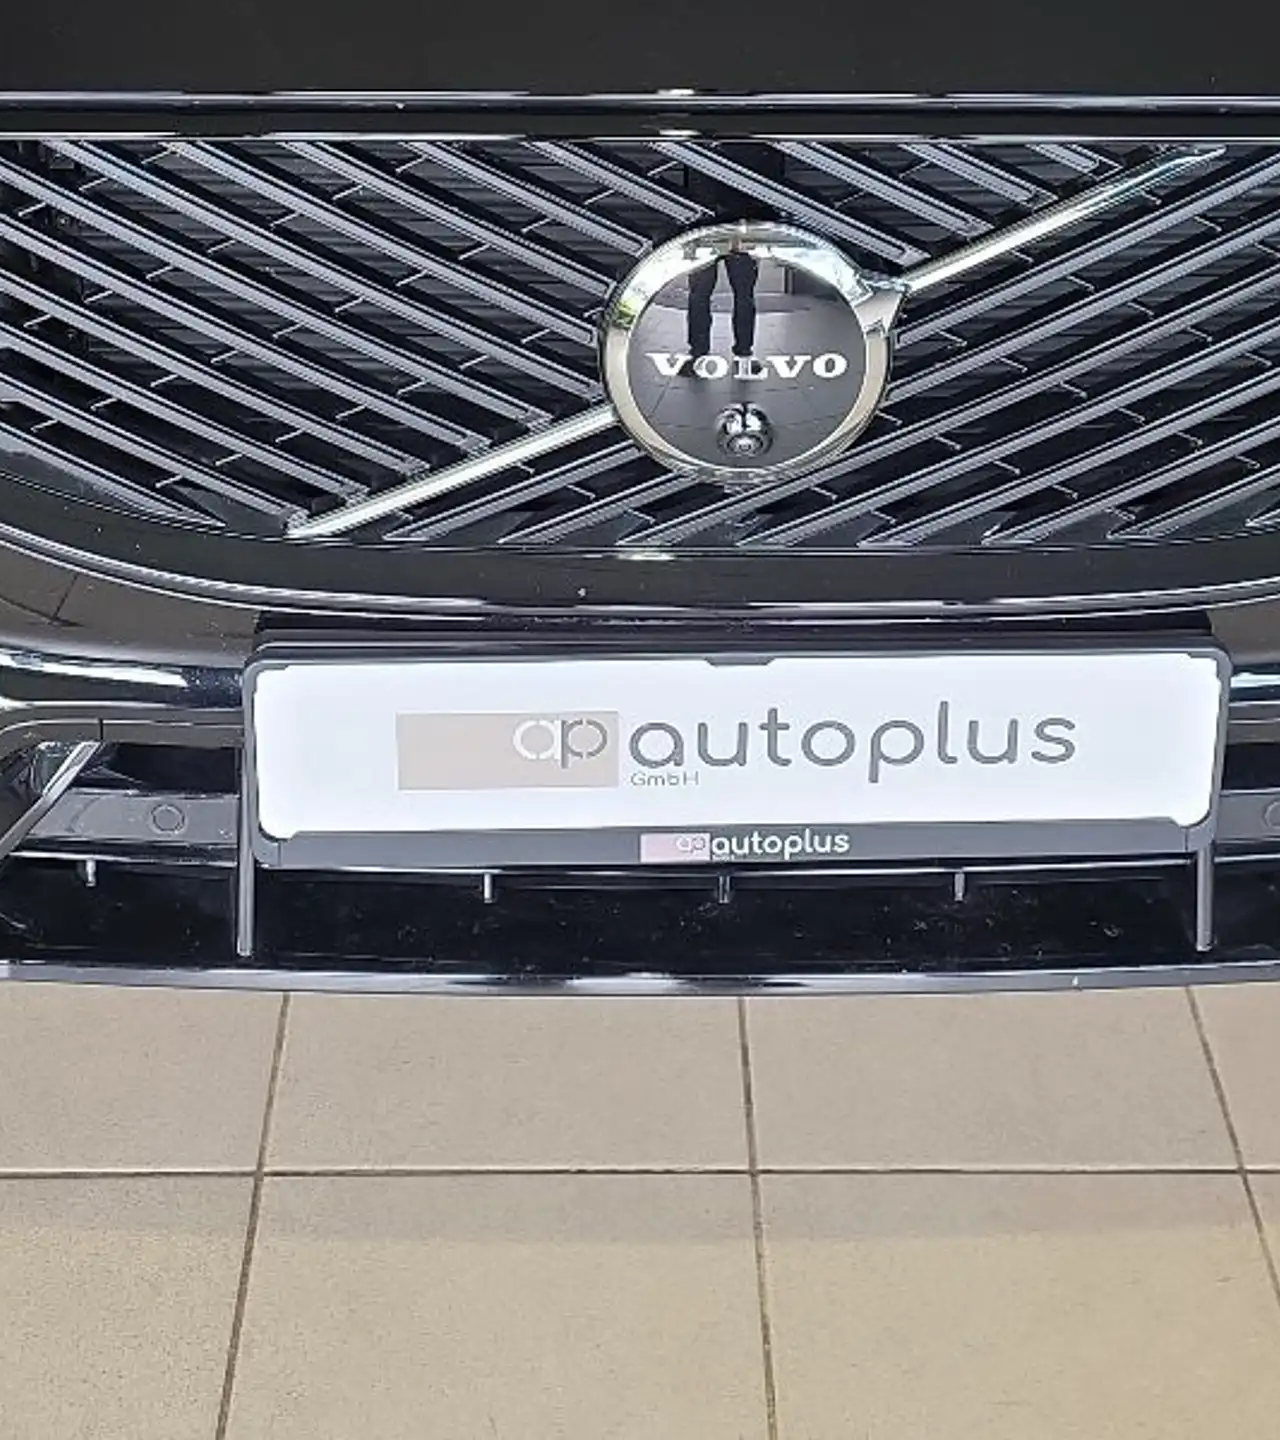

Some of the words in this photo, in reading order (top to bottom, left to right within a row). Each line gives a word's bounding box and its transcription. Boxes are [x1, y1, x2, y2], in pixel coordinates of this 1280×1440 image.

[645, 352, 849, 380] VOLVO
[628, 700, 1077, 784] autoplus
[630, 770, 700, 787] GmbH
[711, 827, 851, 860] autoplus
